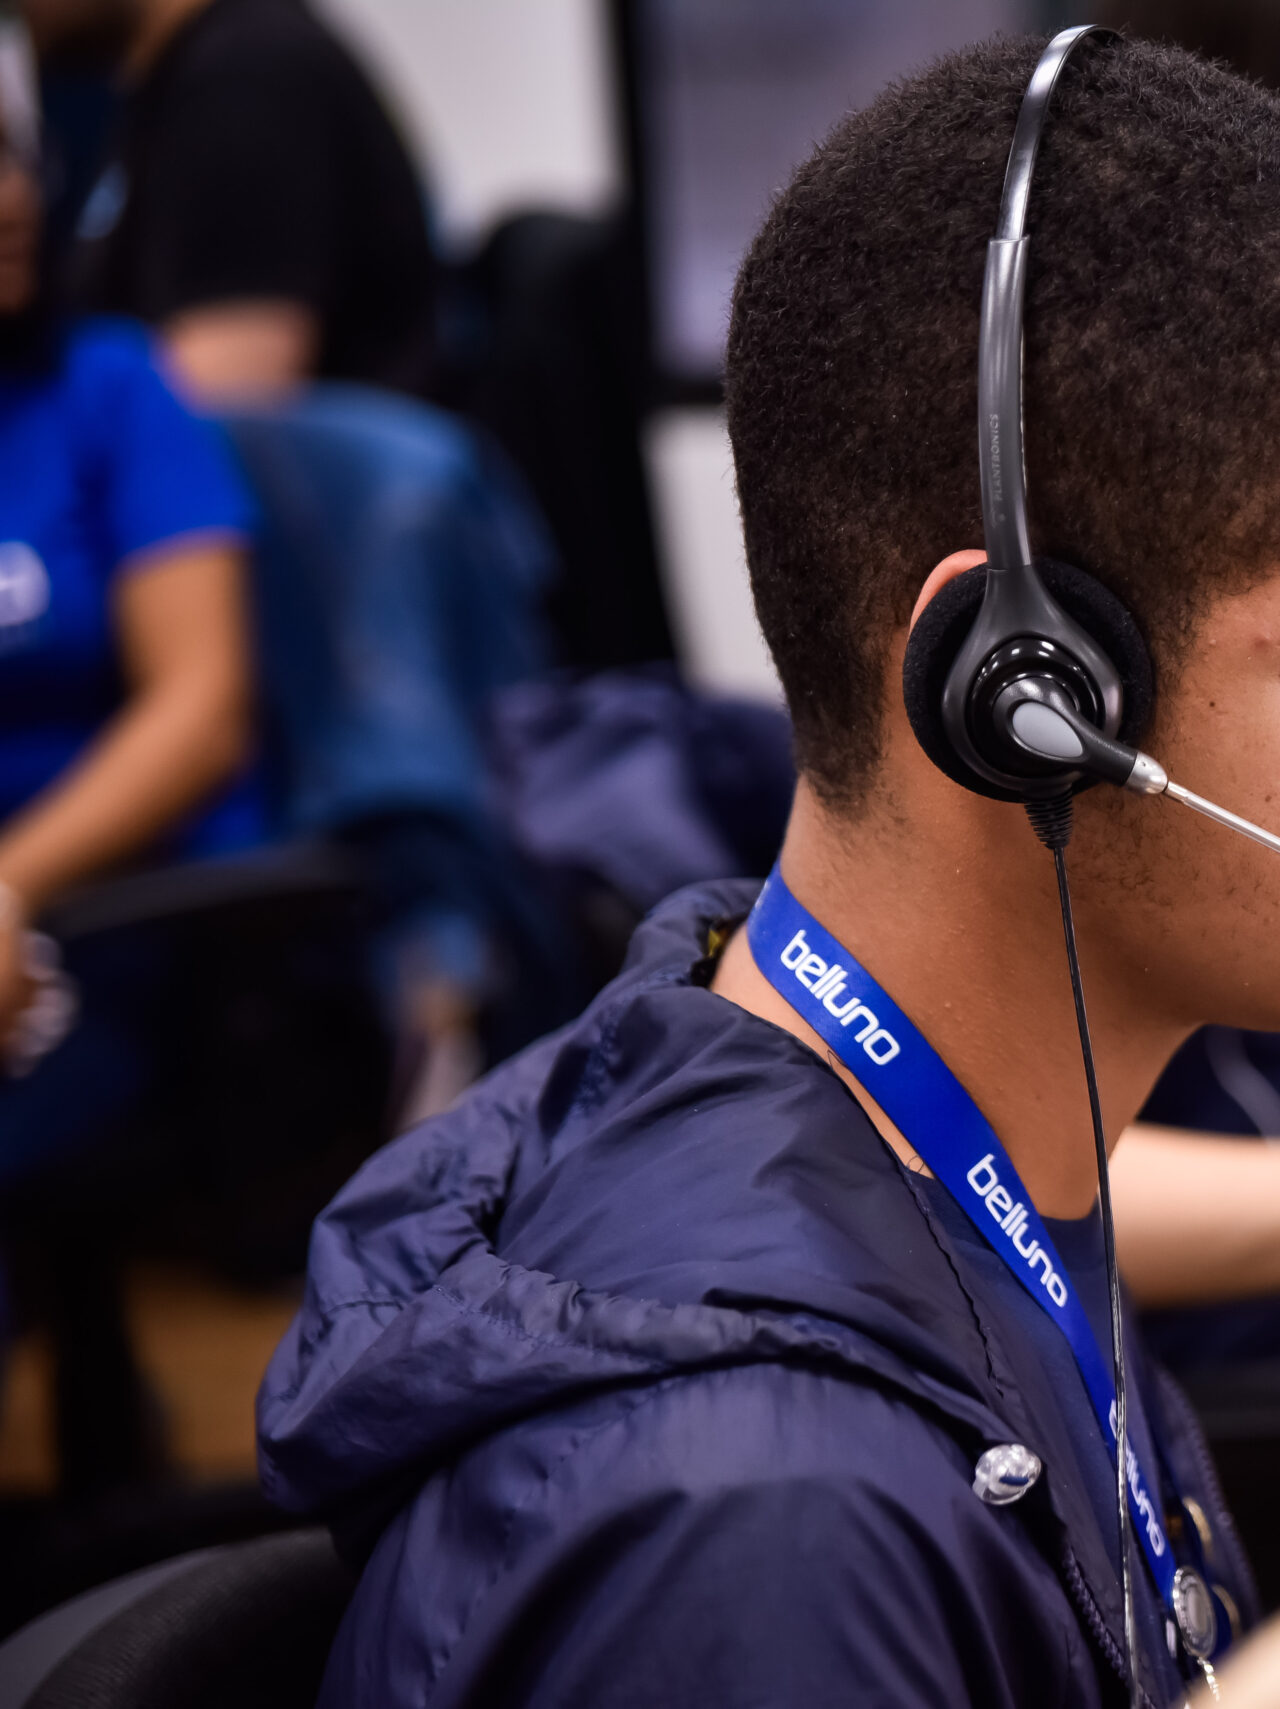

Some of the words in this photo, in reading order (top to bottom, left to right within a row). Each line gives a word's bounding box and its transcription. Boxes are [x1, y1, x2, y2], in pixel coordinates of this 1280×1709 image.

[989, 413, 1003, 502] PLANTRONICS
[780, 929, 901, 1066] belluno
[966, 1153, 1068, 1308] belluno
